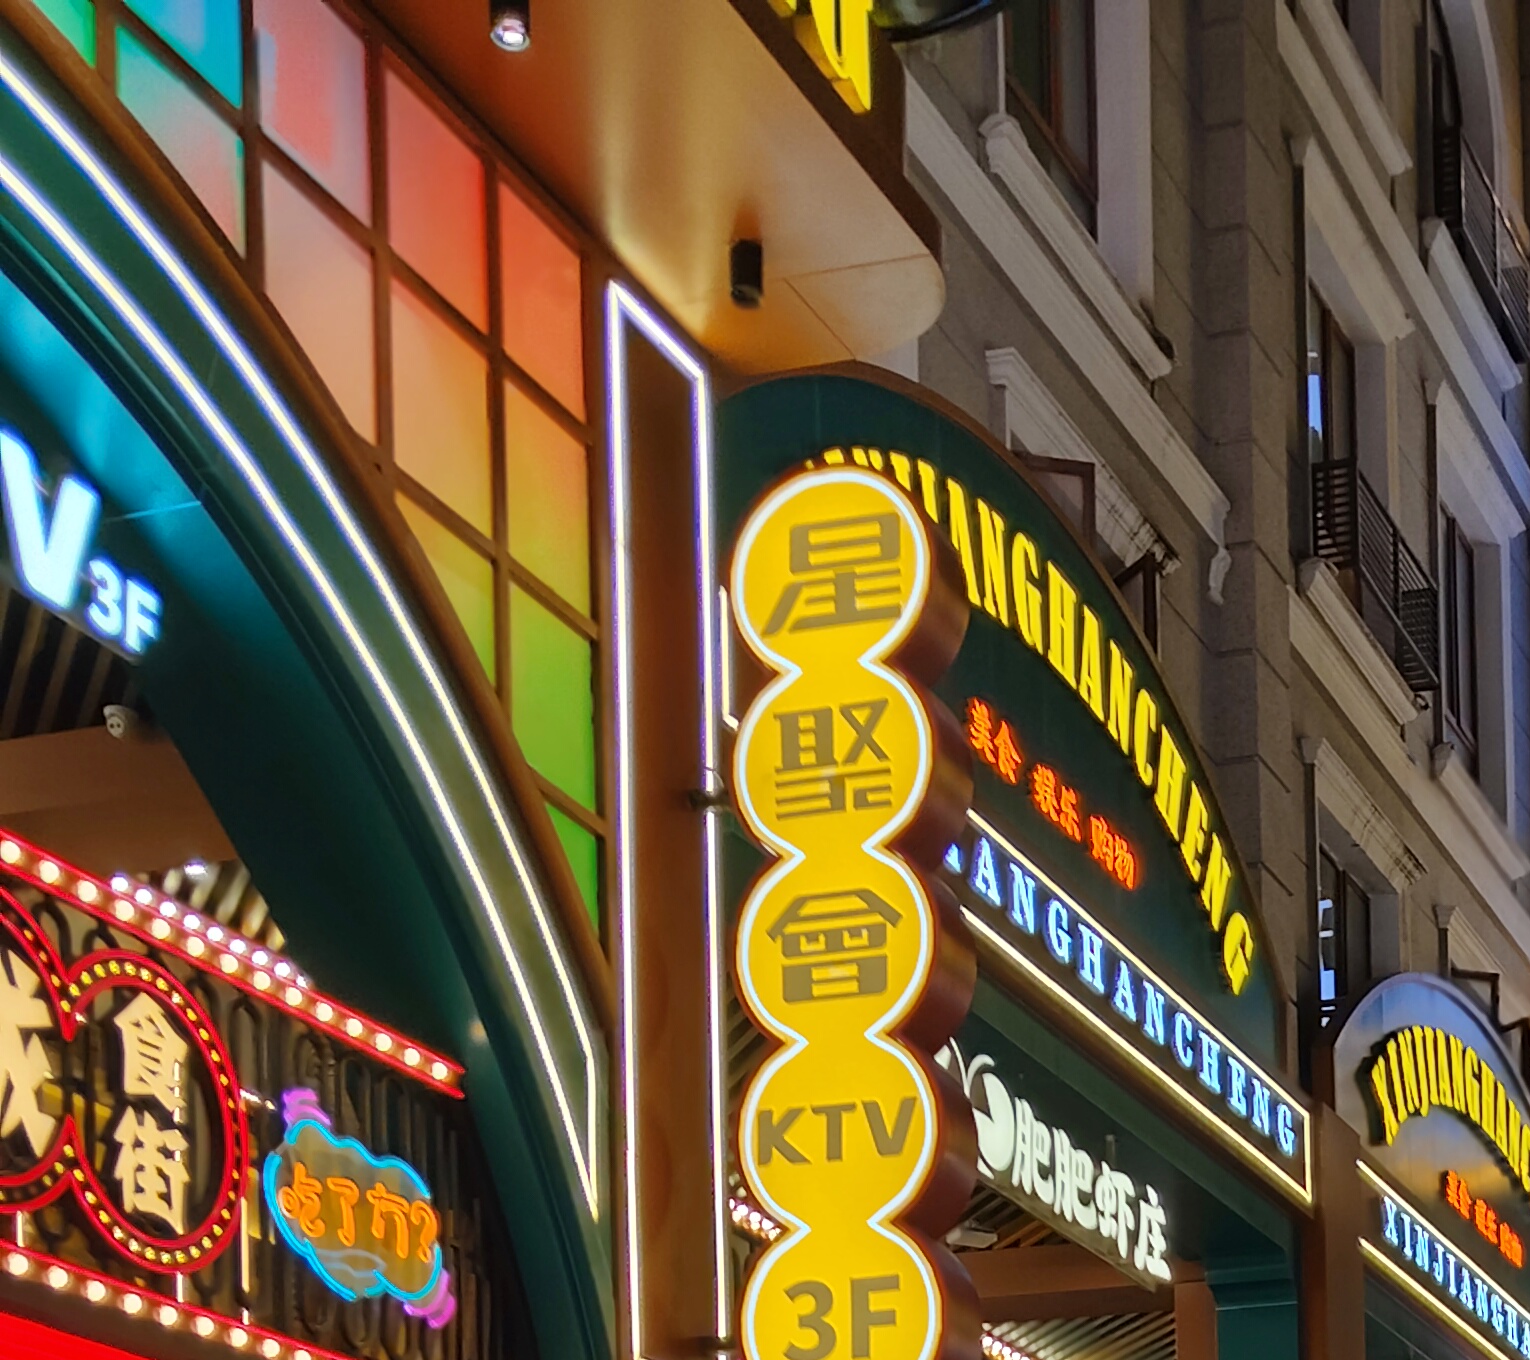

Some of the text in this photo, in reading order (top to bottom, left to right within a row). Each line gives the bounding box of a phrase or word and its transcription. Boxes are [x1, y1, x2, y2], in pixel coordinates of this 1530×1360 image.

[86, 556, 165, 655] 3F
[761, 510, 905, 1004] 星聚會
[968, 696, 1137, 891] 美食 娱乐 购物
[944, 832, 1299, 1157] ANGHANCHENG
[112, 990, 191, 1236] 食街
[756, 1096, 918, 1167] KTV
[1010, 1095, 1173, 1283] 肥肥虾庄
